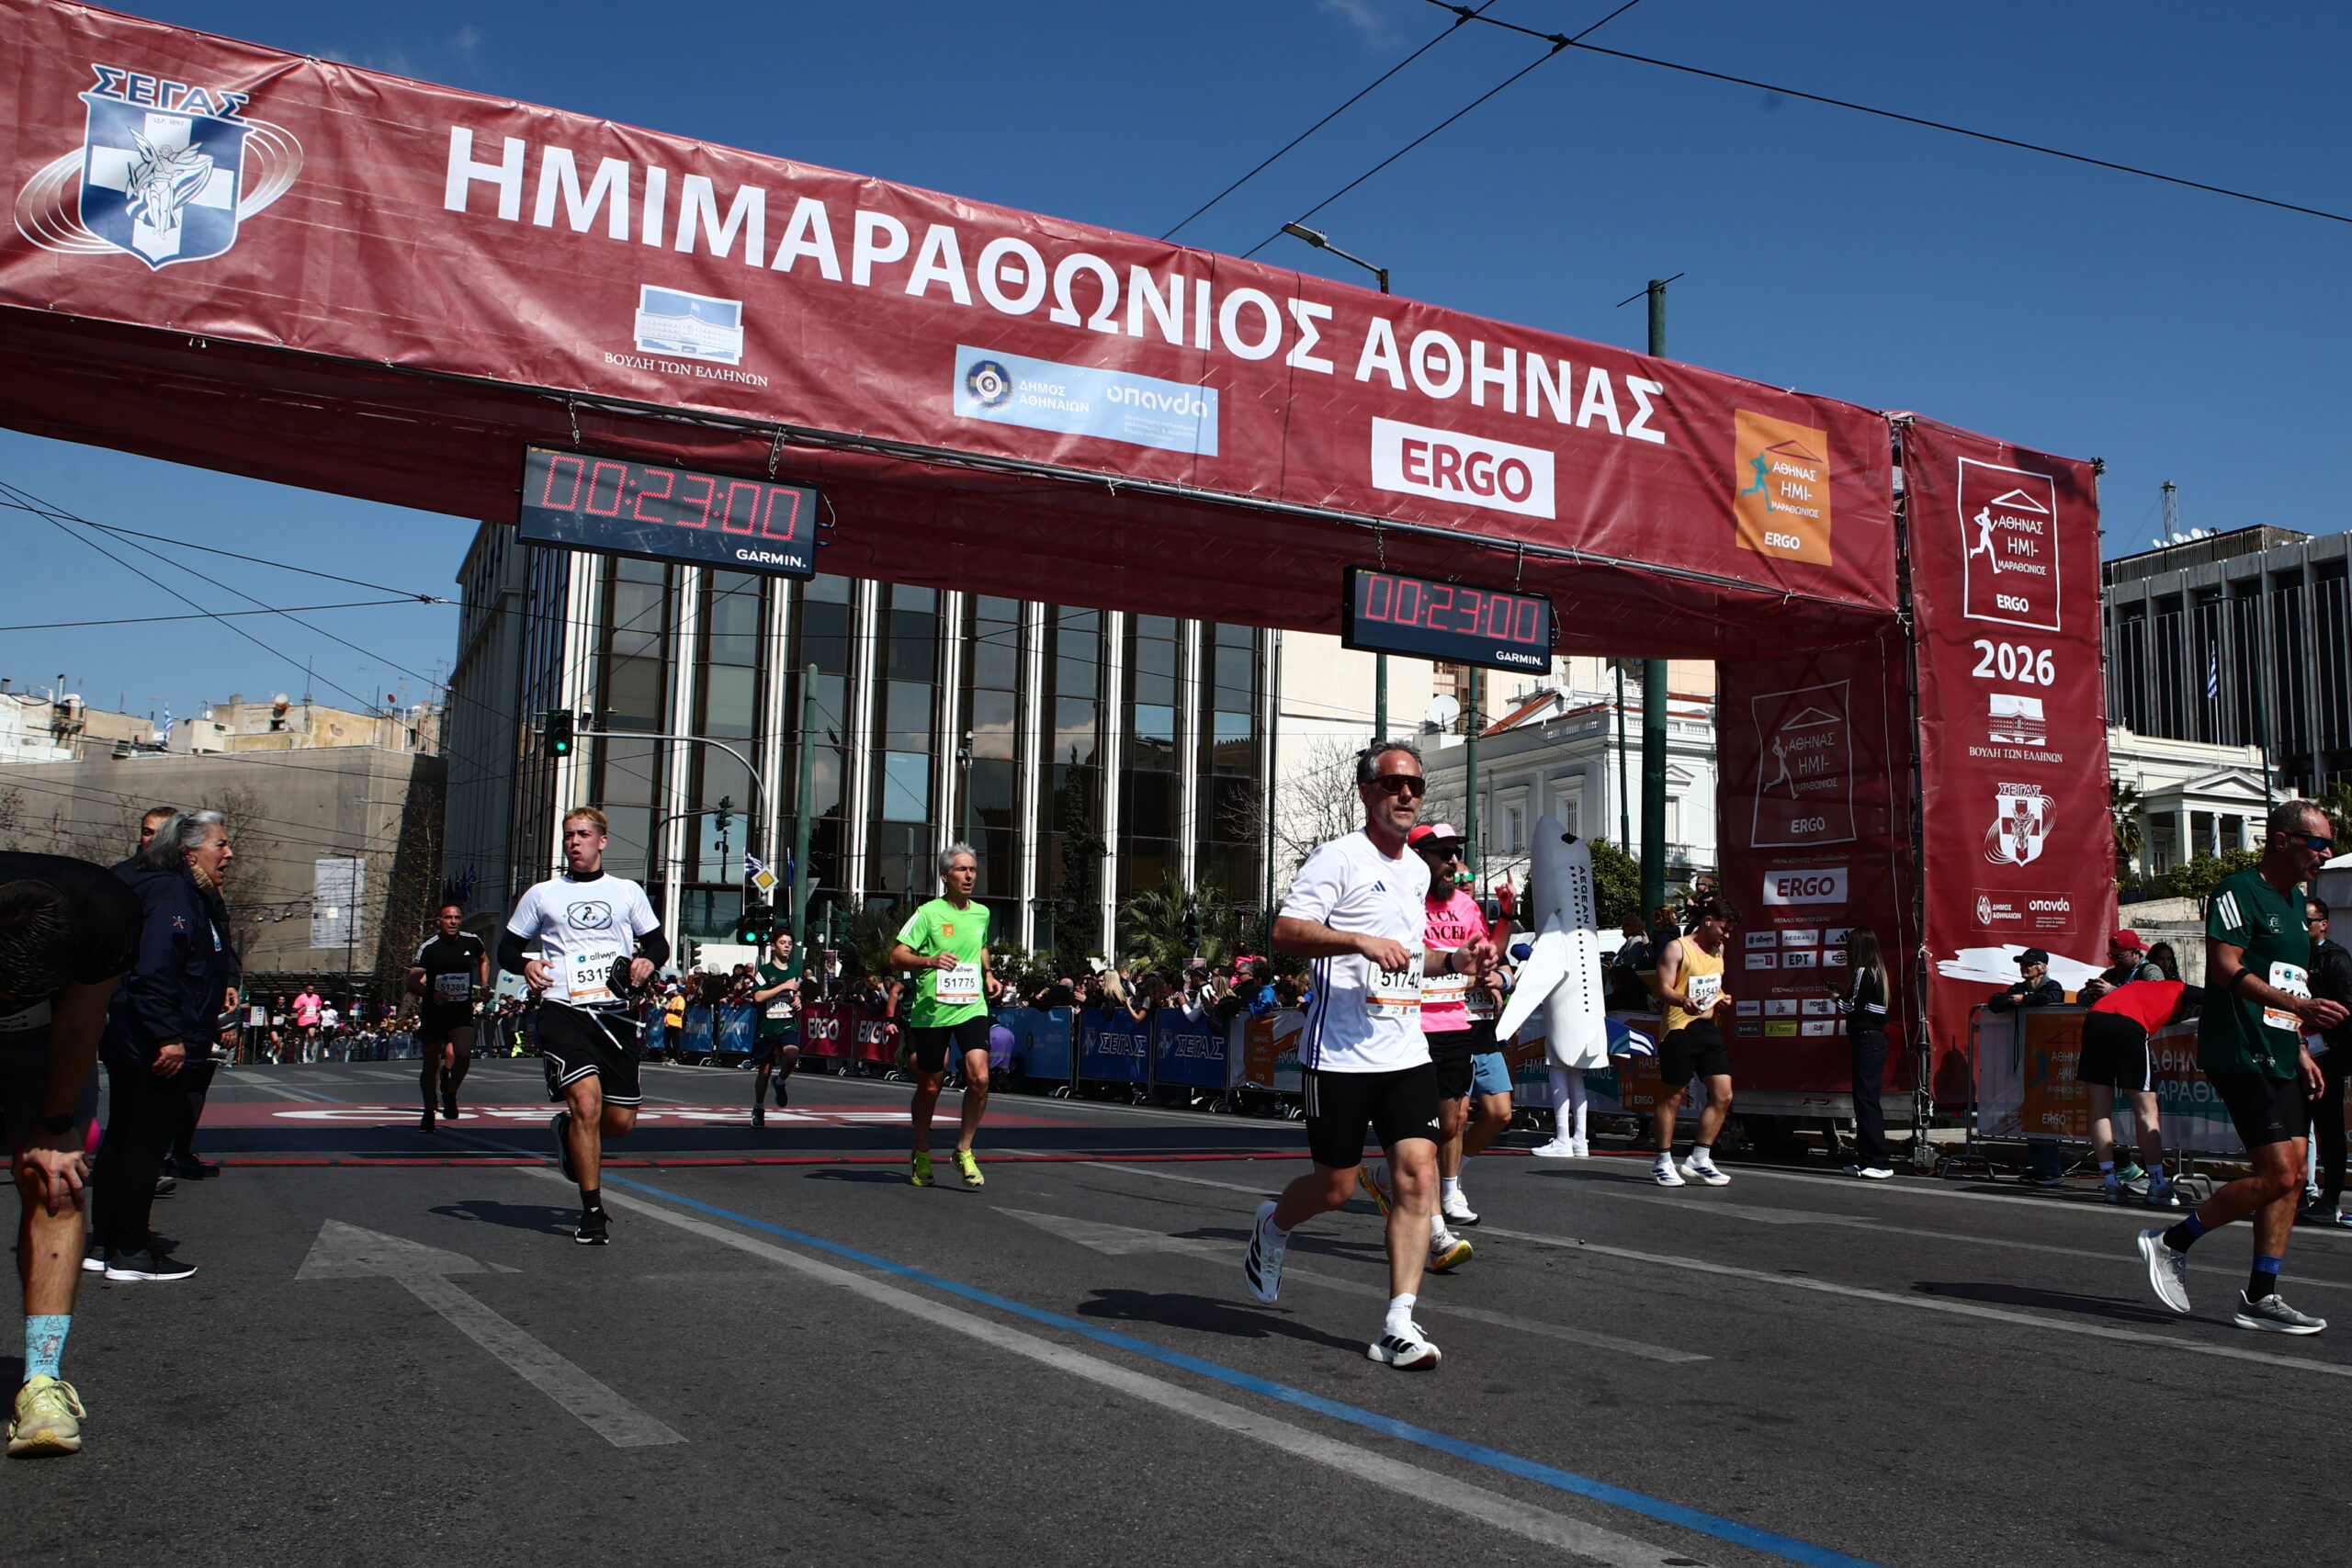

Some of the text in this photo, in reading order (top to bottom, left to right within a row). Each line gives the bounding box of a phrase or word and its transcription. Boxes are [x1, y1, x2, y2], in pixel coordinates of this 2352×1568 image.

[89, 63, 249, 123] ΣΕΓΑΣ
[169, 118, 185, 127] 1897
[444, 125, 1666, 445] ΗΜΙΜΑΡΑΘΩΝΙΟΣ ΑΘΗΝΑΣ
[605, 352, 768, 387] ΒΟΥΛΗ ΤΩΝ ΕΛΛΗΝΩΝ
[1019, 379, 1066, 397] ΔΗΜΟΣ
[1019, 393, 1090, 412] ΑΘΗΝΑΙΩΝ
[1401, 437, 1532, 503] ERGO
[1772, 461, 1817, 482] ΑΘΗΝΑΣ
[542, 456, 800, 540] 00:23:00
[1781, 480, 1812, 502] ΗΜΙ-
[1771, 501, 1819, 518] ΜΑΡΑΘΩΝΙΟΣ
[1997, 515, 2043, 535] ΑΘΗΝΑΣ
[1764, 531, 1800, 549] ERGO
[2007, 536, 2039, 557] ΗΜΙ-
[1998, 560, 2047, 575] ΜΑΡΑΘΩΝΙΟΣ
[1365, 576, 1539, 642] 00:23:00
[1996, 594, 2029, 613] ERGO
[1973, 639, 2055, 686] 2026
[1789, 732, 1836, 752] ΑΘΗΝΑΣ
[1798, 754, 1829, 774] ΗΜΙ-
[1969, 746, 2063, 762] ΒΟΥΛΗ ΤΩΝ ΕΛΛΗΝΩΝ
[1997, 783, 2041, 797] ΣΕΓΑΣ
[1791, 816, 1826, 833] ERGO
[1578, 865, 1589, 924] AEGEAN
[1777, 876, 1835, 897] ERGO
[590, 951, 616, 961] allwyn
[1789, 953, 1809, 965] ΕΡΤ
[944, 977, 975, 987] 51775
[1381, 971, 1420, 988] 51742
[808, 1017, 840, 1041] ERGO
[1098, 1032, 1147, 1056] ΣΕΓΑΣ
[1175, 1034, 1225, 1060] ΣΕΓΑΣ
[2042, 1112, 2067, 1124] ERGO
